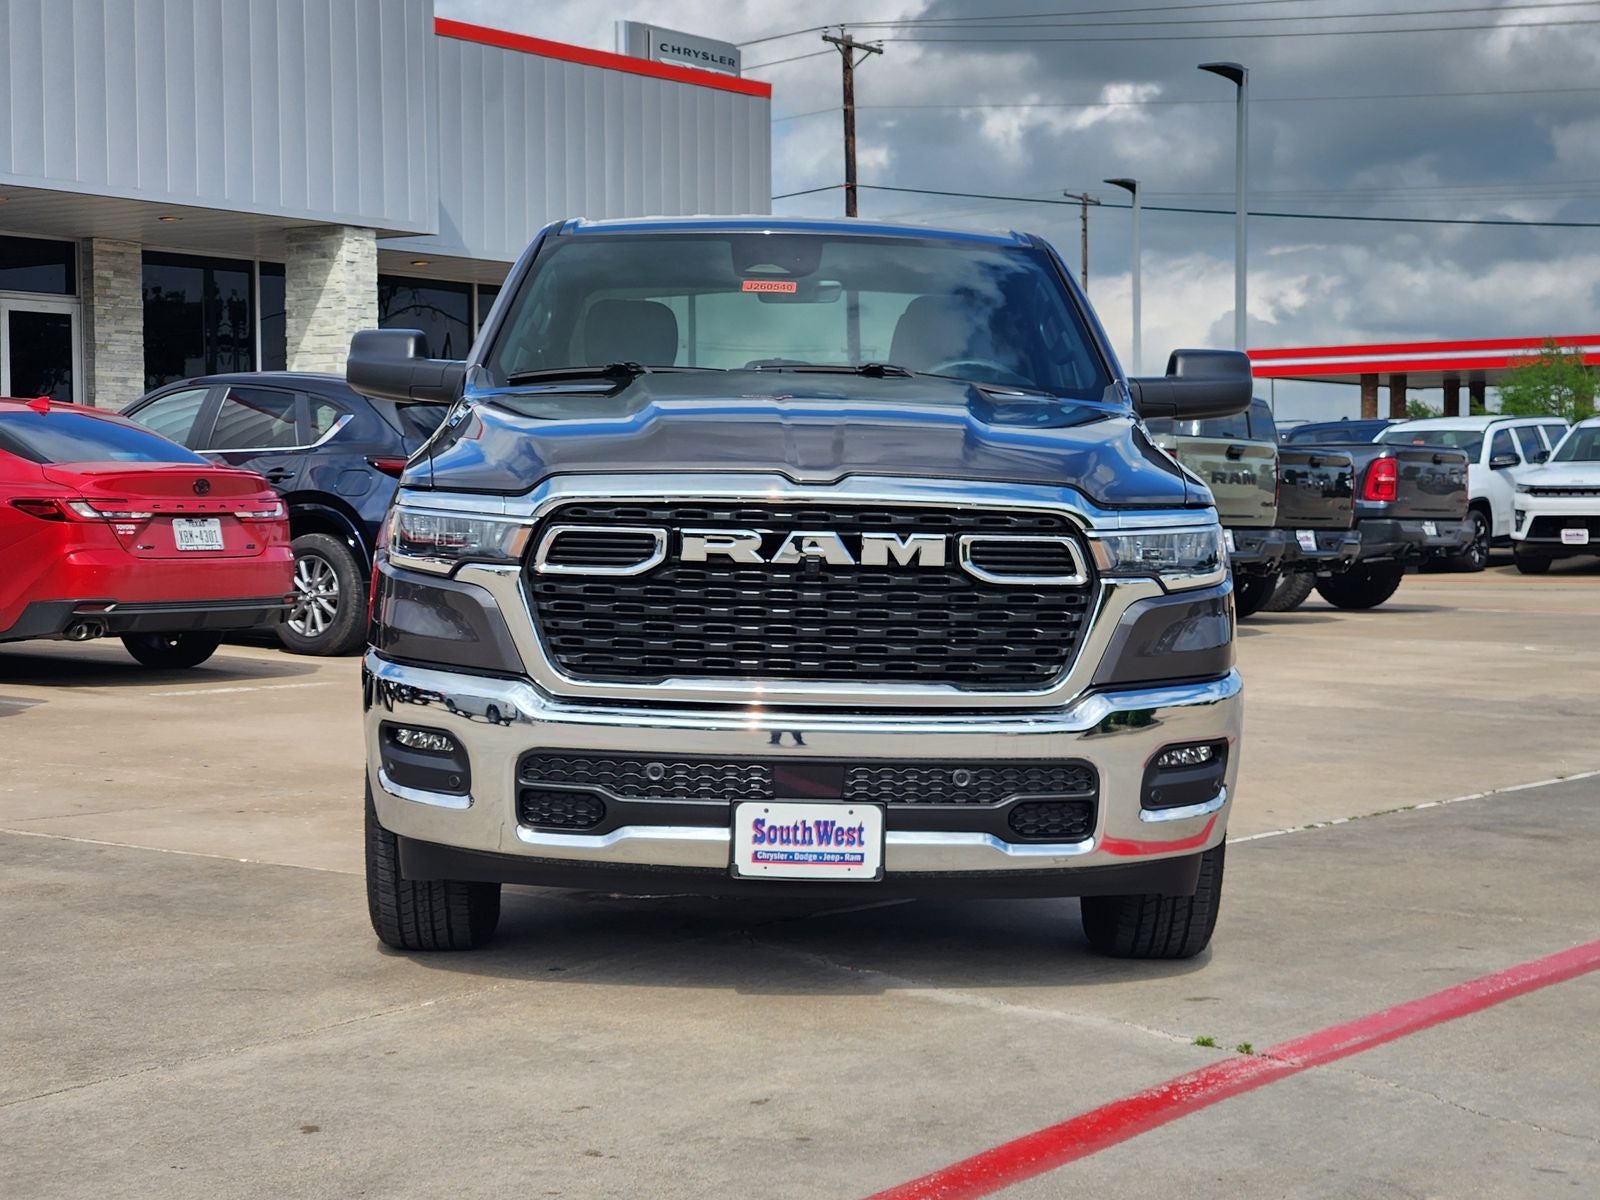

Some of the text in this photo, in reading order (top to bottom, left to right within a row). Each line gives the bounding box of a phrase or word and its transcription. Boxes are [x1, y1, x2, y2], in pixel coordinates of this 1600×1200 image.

[660, 43, 736, 67] CHRYSLER
[746, 283, 793, 291] J260540
[1212, 471, 1257, 485] RAM
[680, 528, 947, 567] RAM
[752, 818, 865, 847] SouthWest
[757, 851, 862, 862] Chrysler Dodge Jeep Ram
